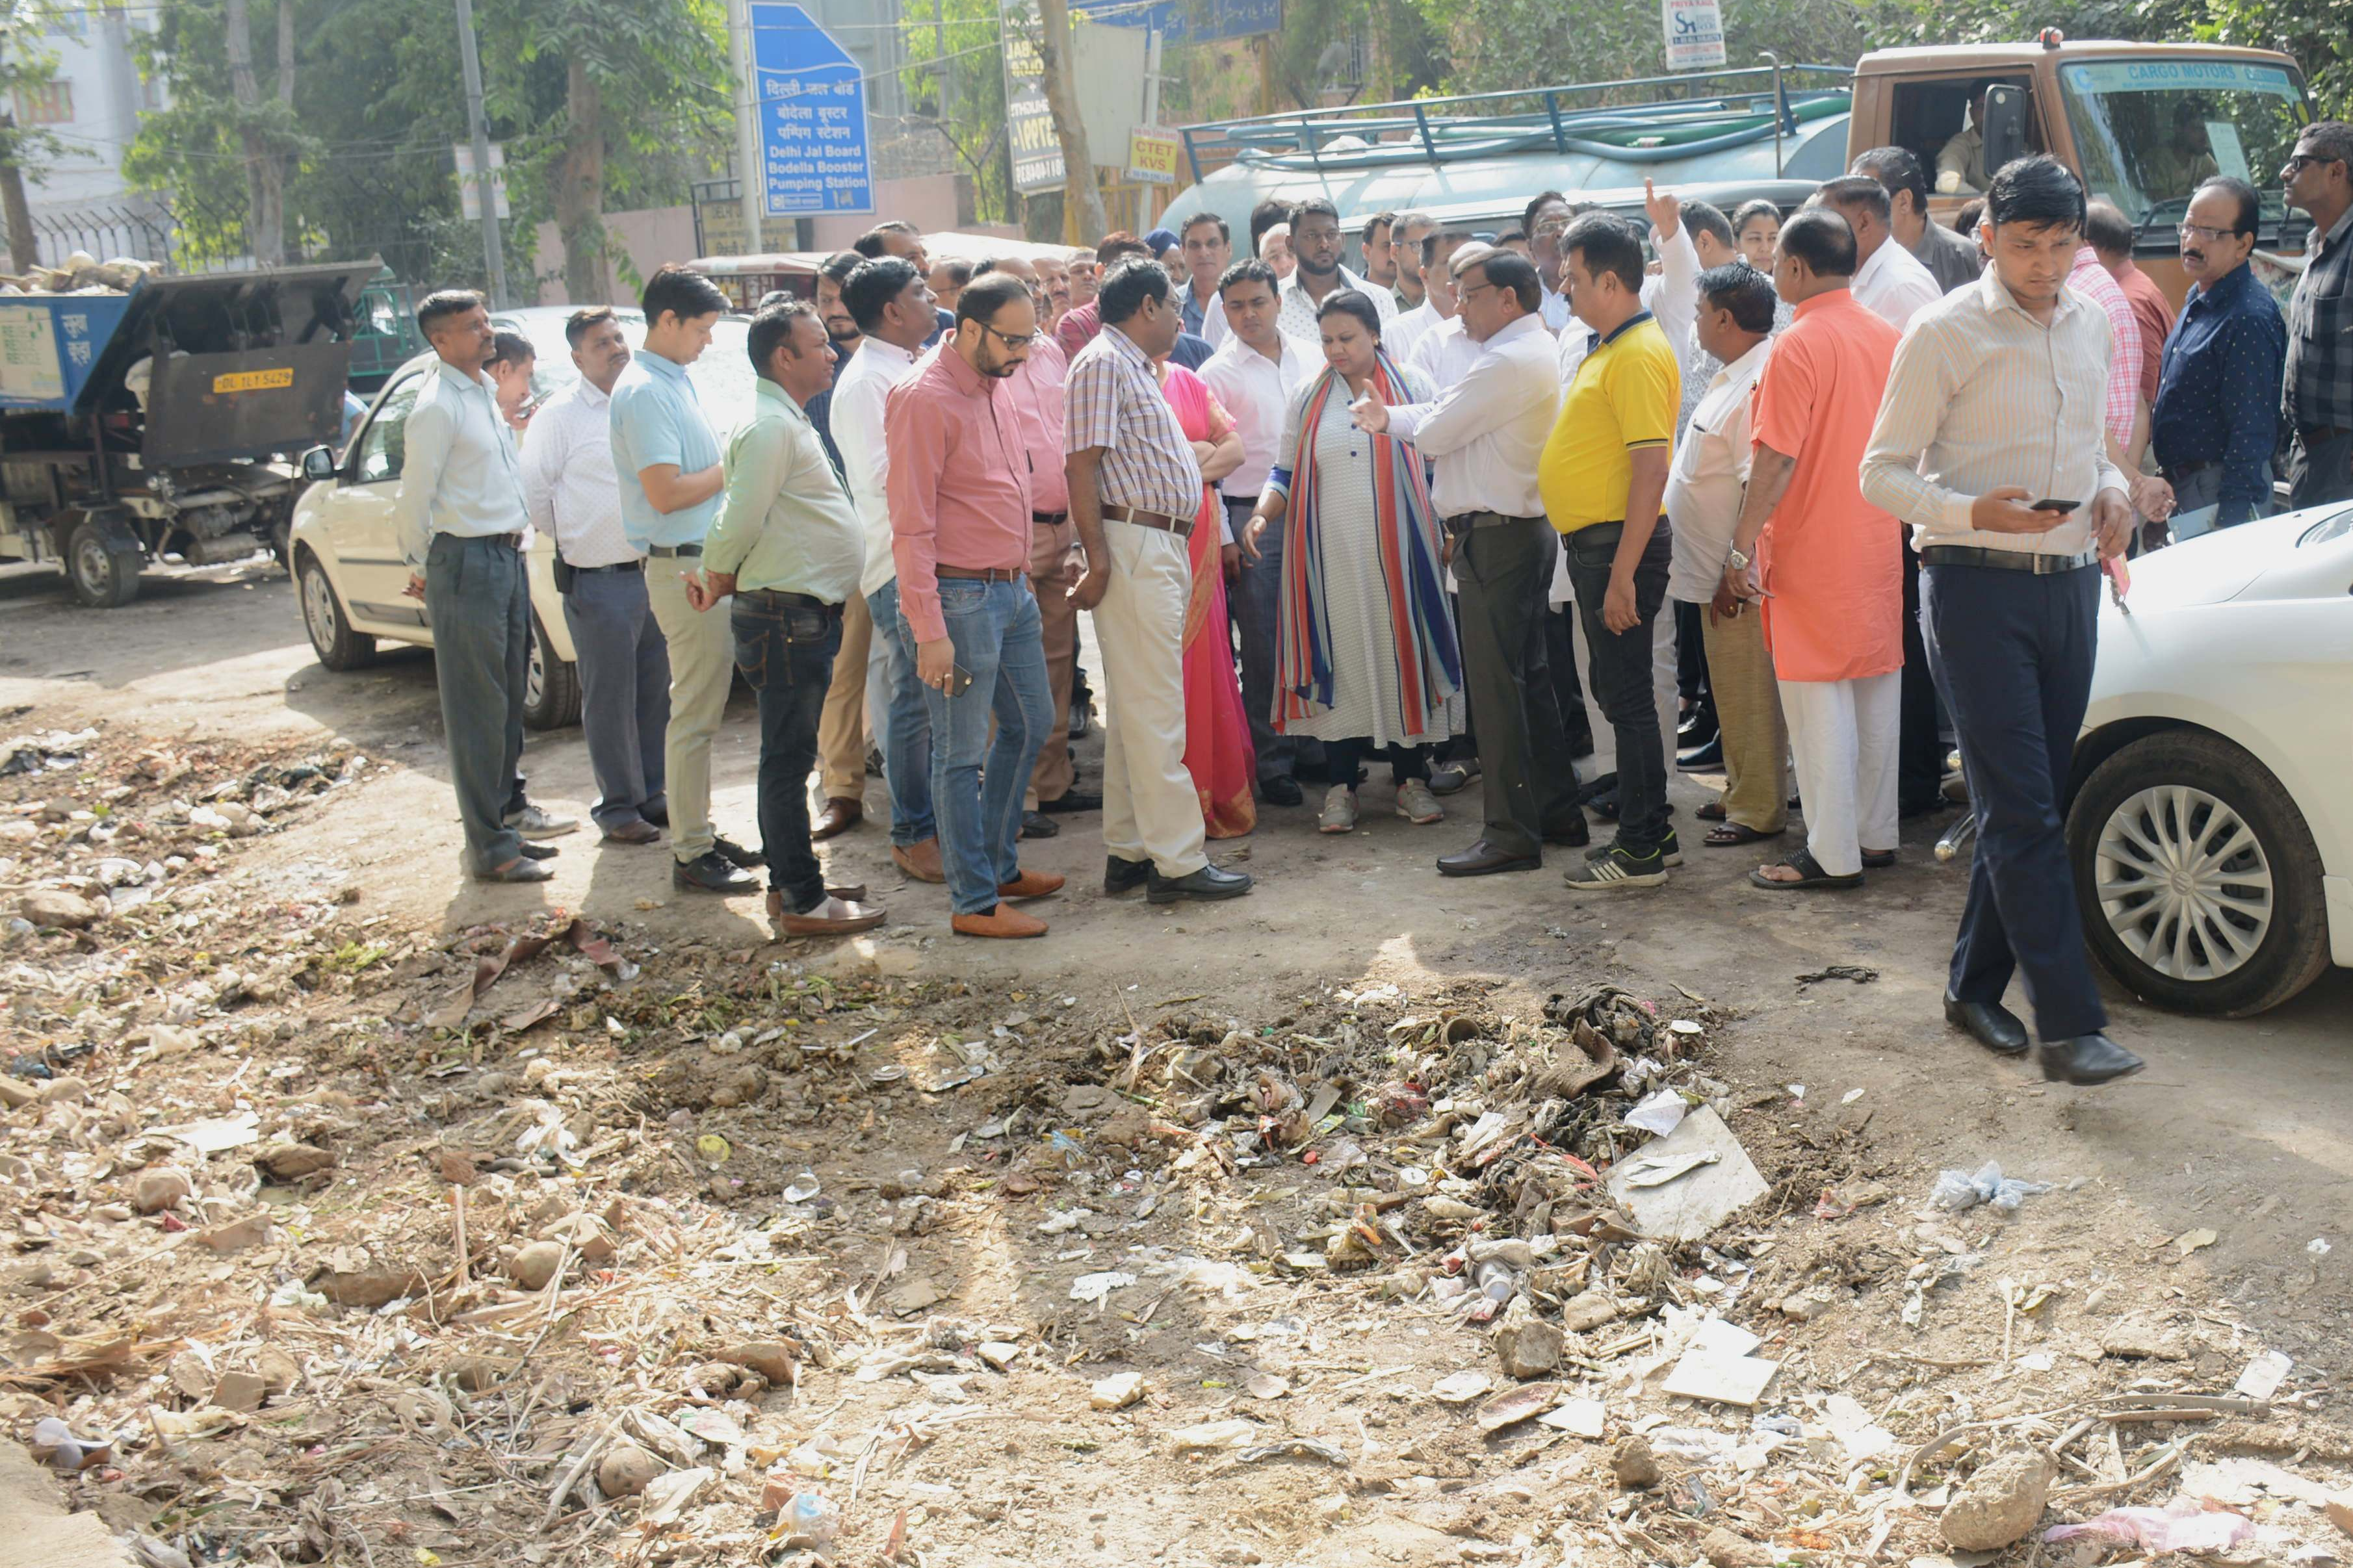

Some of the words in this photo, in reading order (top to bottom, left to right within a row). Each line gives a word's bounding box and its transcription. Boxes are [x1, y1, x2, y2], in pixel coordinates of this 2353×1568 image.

[2128, 65, 2179, 80] CARGO
[2183, 64, 2236, 79] MOTORS
[770, 145, 801, 159] Delhi
[804, 146, 822, 159] Jal
[826, 145, 861, 158] Board
[1136, 141, 1173, 157] CTET
[768, 161, 814, 174] Bodella
[818, 161, 864, 174] Booster
[1139, 156, 1166, 170] KVS
[769, 177, 822, 193] Pumping
[826, 176, 867, 189] Station
[223, 377, 235, 388] DL
